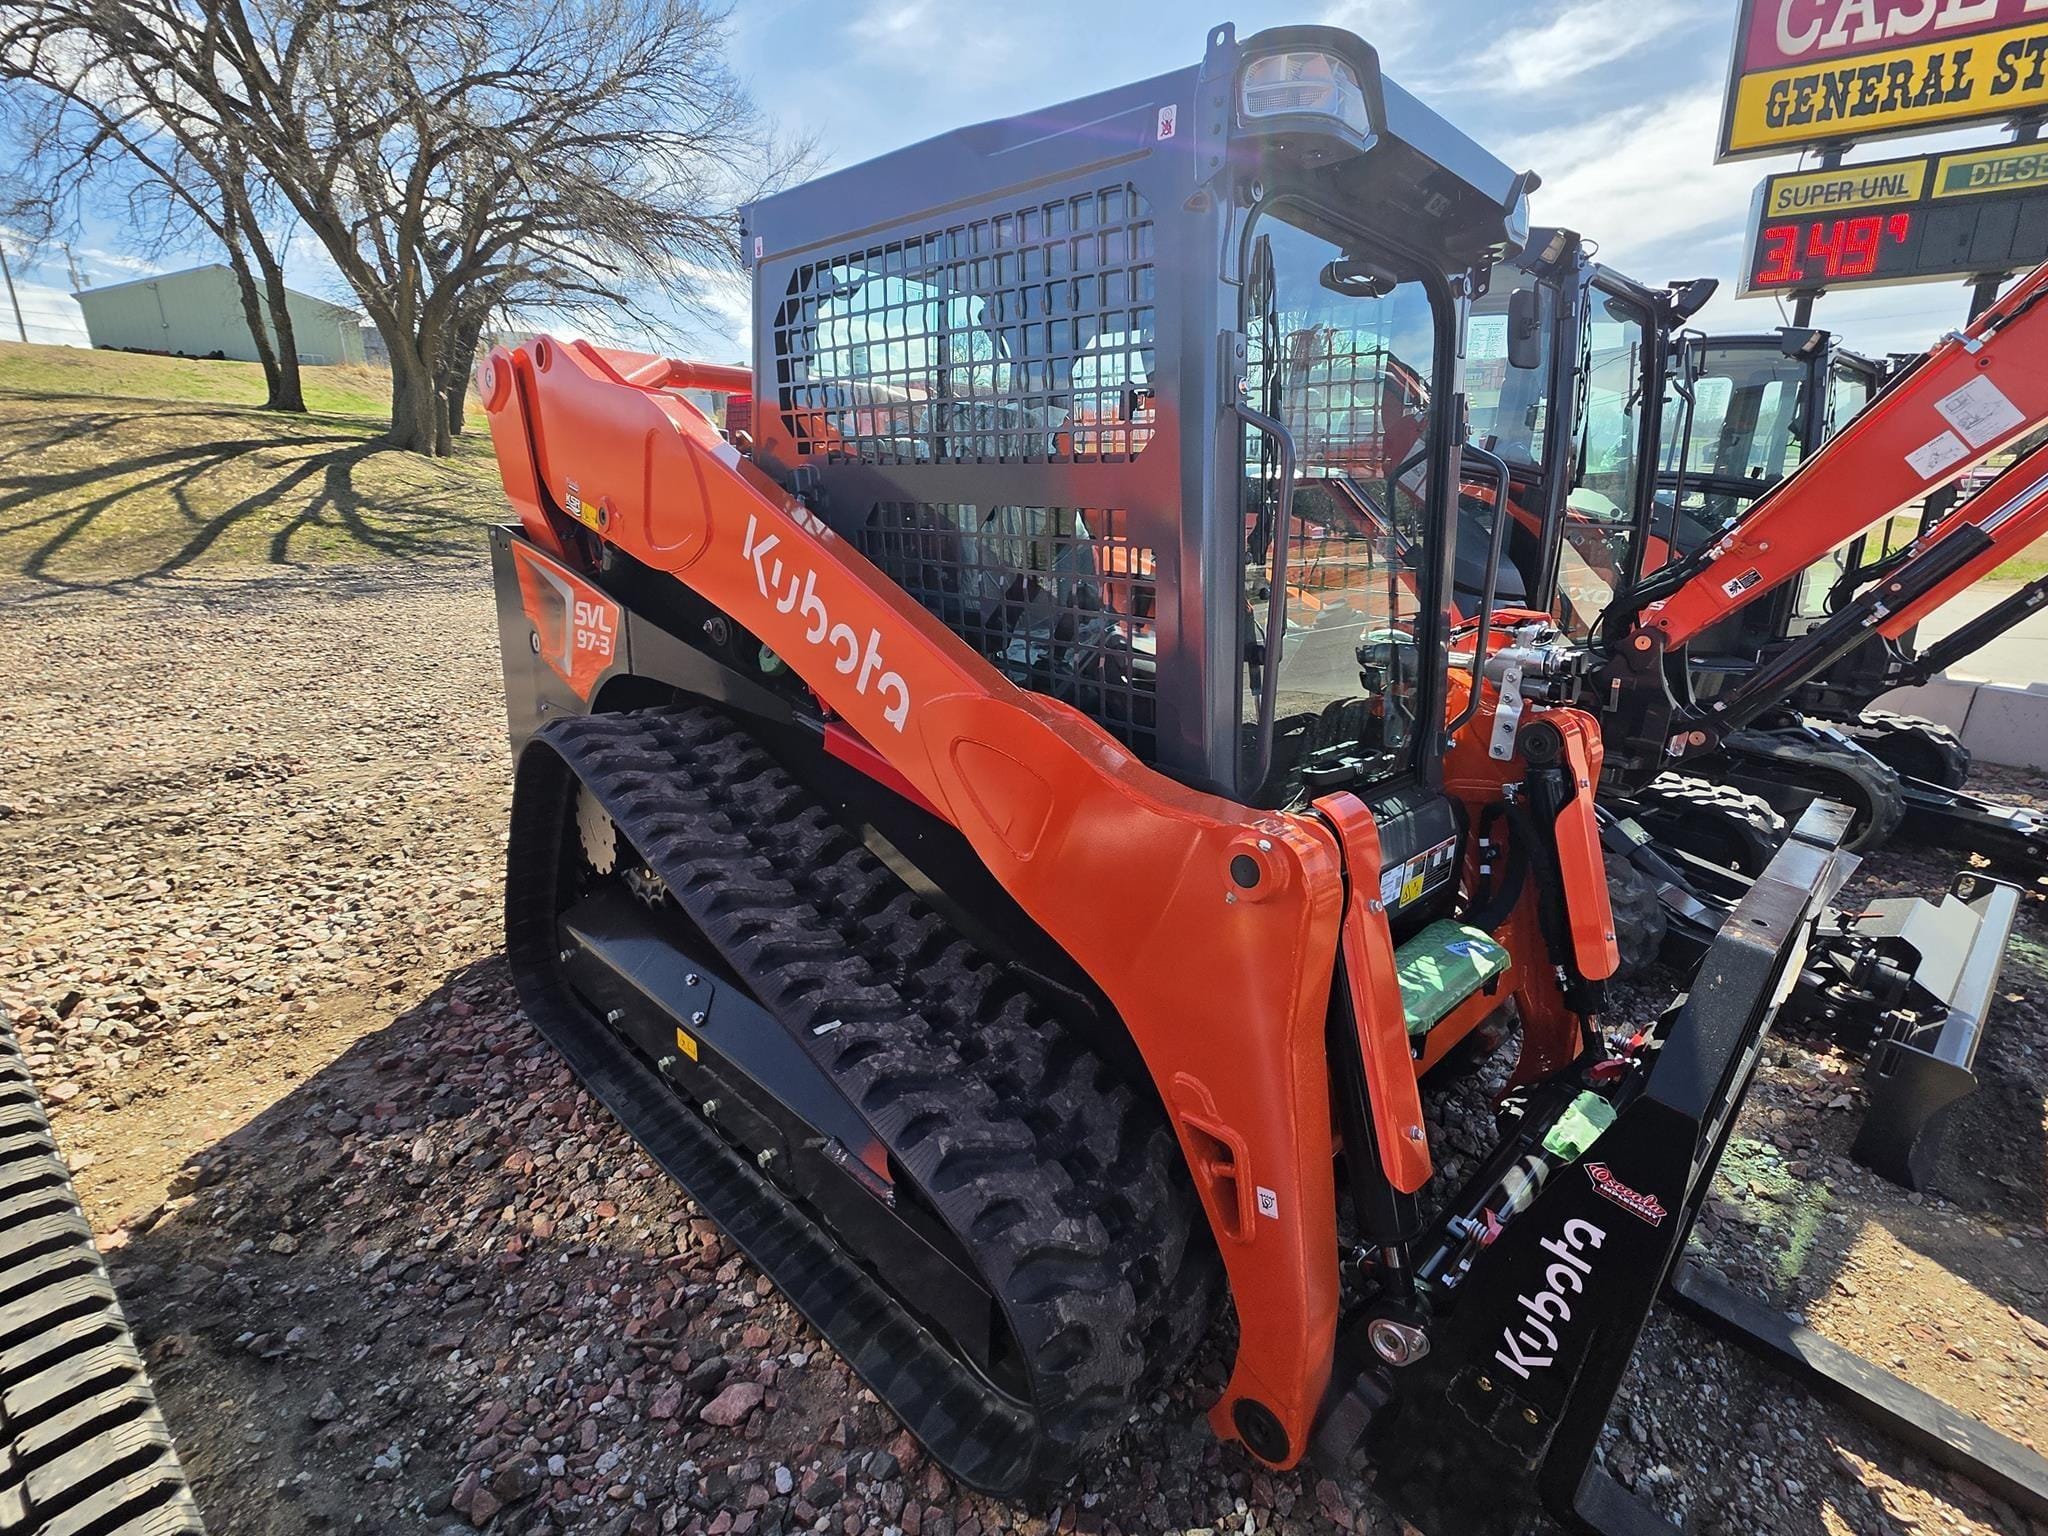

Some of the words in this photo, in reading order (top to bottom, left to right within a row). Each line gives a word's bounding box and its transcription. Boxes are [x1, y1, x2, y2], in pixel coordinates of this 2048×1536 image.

[1766, 48, 1974, 128] GENERAL
[1777, 181, 1853, 210] SUPER
[1860, 174, 1909, 199] UNL
[574, 601, 612, 633] SVL
[743, 514, 909, 733] Kubota
[577, 629, 610, 656] 97-3
[1589, 1165, 1666, 1215] Osceola
[1600, 1183, 1658, 1219] IMPLEMENT
[1495, 1218, 1606, 1379] Kubota
